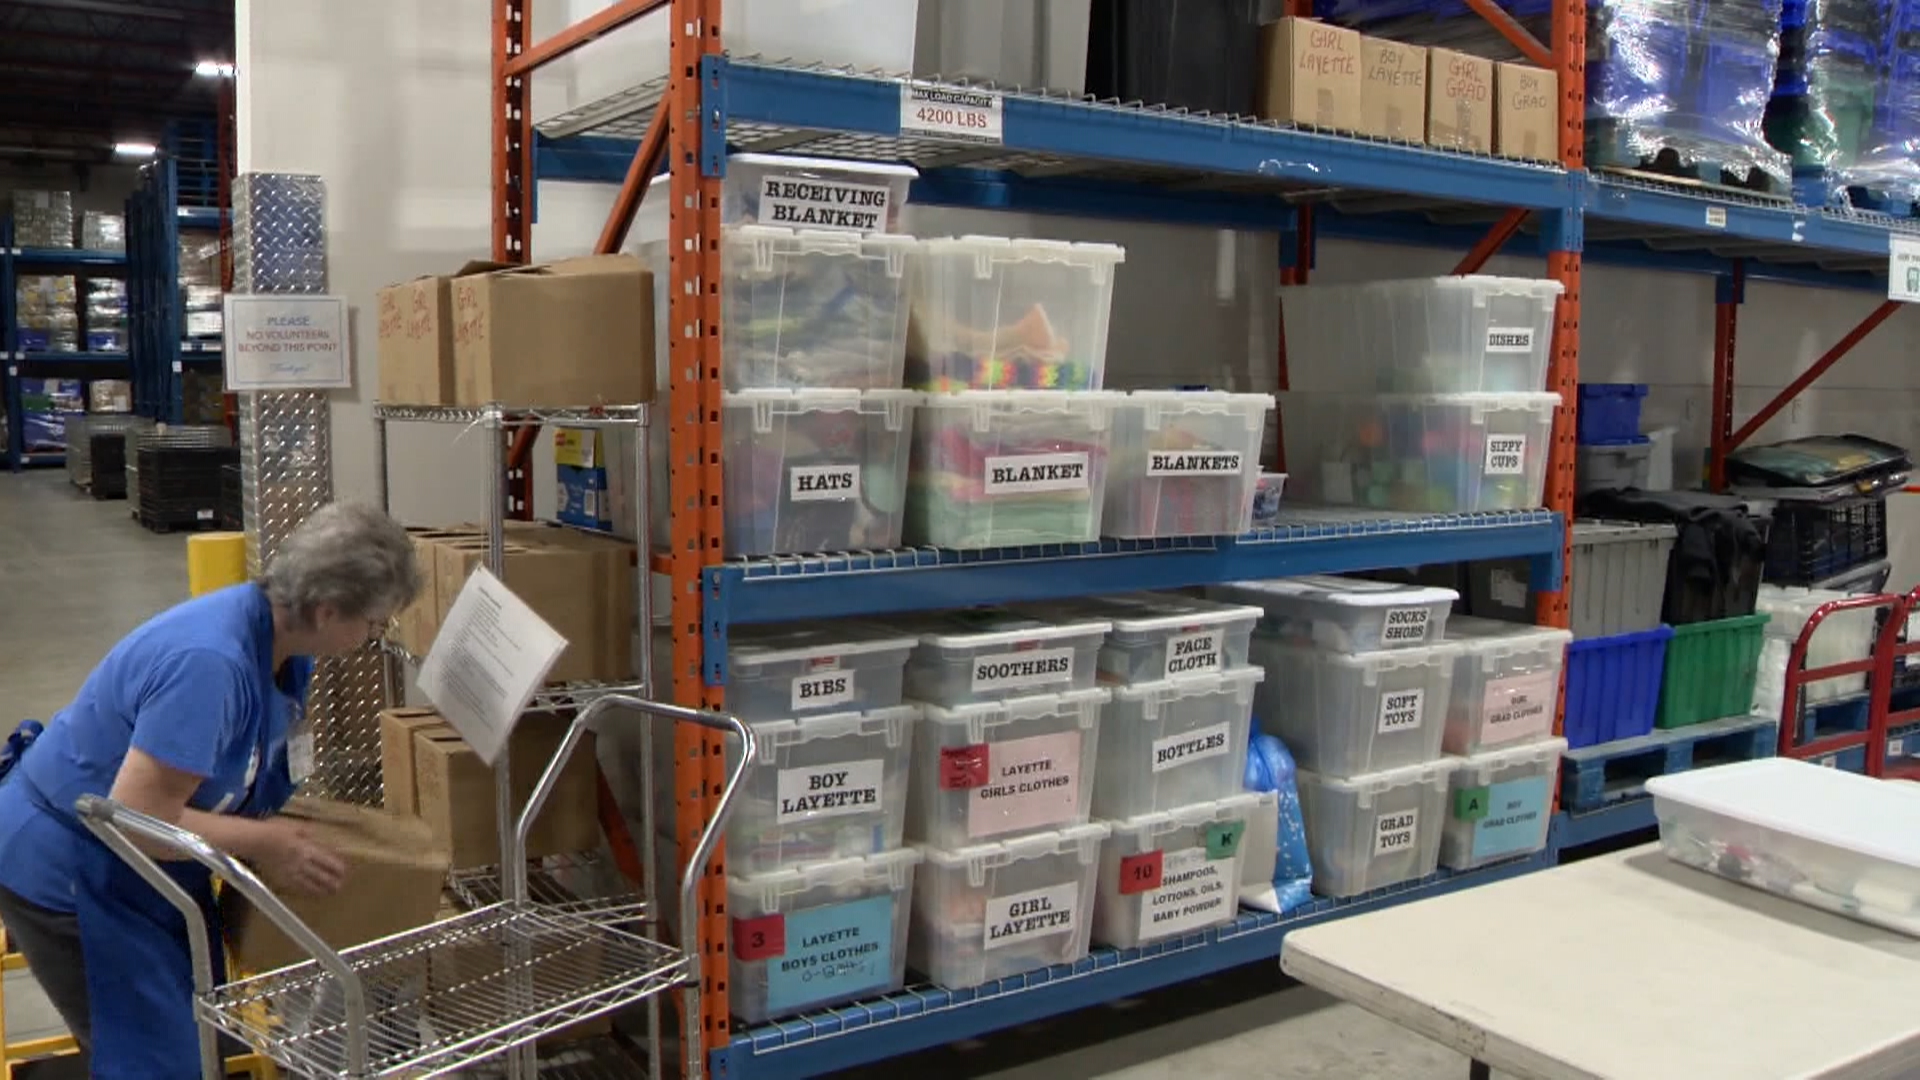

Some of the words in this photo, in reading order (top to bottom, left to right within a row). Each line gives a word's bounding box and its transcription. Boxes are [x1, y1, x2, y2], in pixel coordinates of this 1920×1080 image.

[1310, 29, 1344, 51] GIRL
[1300, 51, 1354, 75] LAYETTE
[1380, 49, 1405, 67] BOY
[1368, 65, 1422, 86] LAYETTE
[1449, 59, 1483, 83] GIRL
[1446, 77, 1487, 101] GRAD
[1519, 74, 1539, 91] BOY
[912, 89, 929, 99] MAX
[930, 91, 952, 102] LOAD
[954, 94, 992, 107] CAPACITY
[1512, 92, 1547, 110] GRAD
[917, 107, 954, 124] 4200
[957, 111, 987, 128] LBS
[765, 181, 885, 207] RECEIVING
[772, 204, 877, 229] BLANKET
[267, 316, 310, 326] PLEASE
[246, 330, 263, 340] NO
[264, 330, 330, 340] VOLUNTEERS
[1489, 334, 1530, 347] DISHES
[237, 342, 280, 352] BEYOND
[283, 343, 305, 352] THIS
[307, 343, 338, 352] POINT
[1490, 440, 1523, 453] SIPPY
[1151, 455, 1239, 470] BLANKETS
[1490, 455, 1519, 468] CUPS
[798, 473, 853, 491] HATS
[992, 463, 1083, 484] BLANKET
[1388, 610, 1428, 624] SOCKS
[1385, 625, 1424, 639] SHOES
[1175, 637, 1212, 656] FACE
[976, 657, 1069, 680] SOOTHERS
[1168, 652, 1217, 673] CLOTH
[799, 679, 847, 699] BIBS
[1386, 695, 1417, 710] SOFT
[1384, 710, 1416, 726] TOYS
[1490, 712, 1511, 724] GRAD
[1157, 732, 1225, 763] BOTTLES
[1002, 758, 1052, 777] LAYETTE
[808, 772, 849, 791] BOY
[980, 784, 1016, 800] GIRLS
[1019, 775, 1069, 793] CLOTHES
[782, 789, 876, 814] LAYETTE
[1468, 798, 1479, 811] A
[1380, 815, 1414, 831] GRAD
[1221, 833, 1234, 847] K
[1380, 831, 1410, 848] TOYS
[1134, 864, 1153, 880] 10
[1162, 865, 1218, 886] SHAMPOOS,
[1152, 888, 1199, 906] LOTIONS,
[1009, 897, 1052, 917] GIRL
[1153, 909, 1180, 922] BABY
[1183, 897, 1222, 916] POWDER
[990, 909, 1071, 940] LAYETTE
[751, 931, 766, 948] 3
[802, 926, 860, 948] LAYETTE
[781, 954, 818, 972] BOYS
[821, 941, 879, 963] CLOTHES
